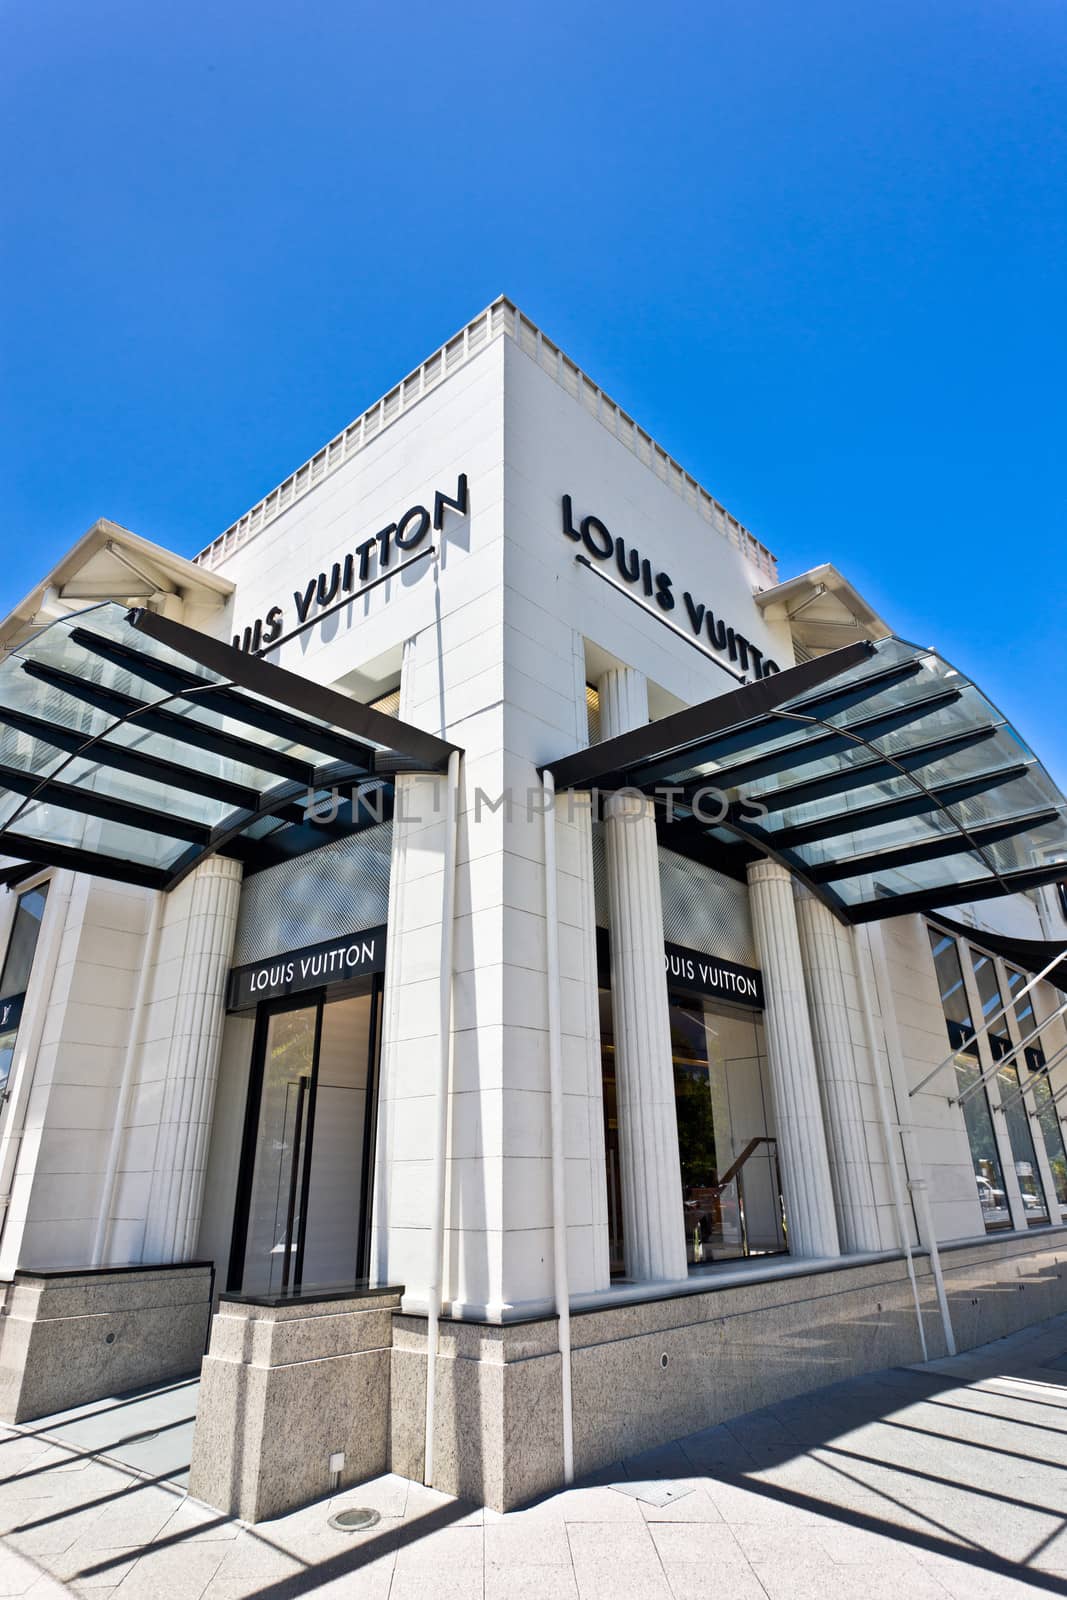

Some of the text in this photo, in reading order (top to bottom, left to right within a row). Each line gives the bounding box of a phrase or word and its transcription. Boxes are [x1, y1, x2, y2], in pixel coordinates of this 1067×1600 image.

[293, 473, 468, 623] VUITTON
[562, 494, 675, 611] LOUIS
[250, 940, 375, 992] LOUIS VUITTON
[699, 962, 757, 997] VUITTON
